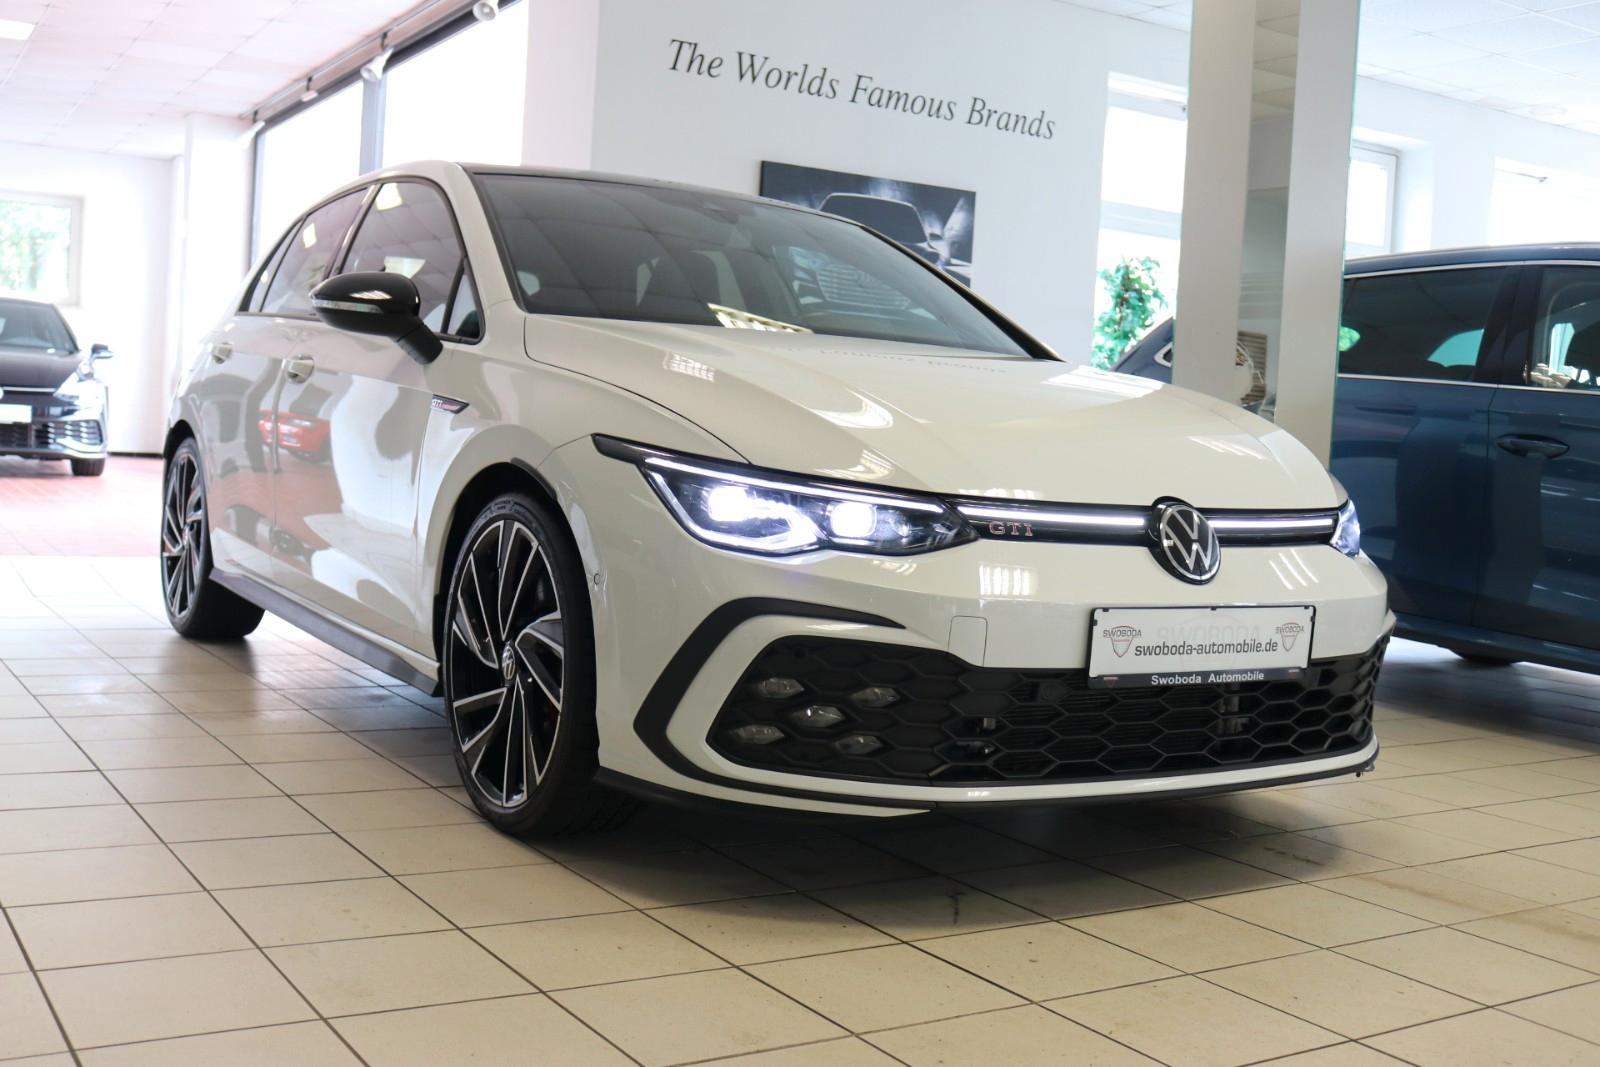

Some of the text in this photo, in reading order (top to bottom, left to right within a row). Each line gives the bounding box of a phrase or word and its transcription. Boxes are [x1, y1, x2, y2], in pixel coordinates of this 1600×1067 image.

[668, 38, 1056, 140] The Worlds Famous Brands
[988, 521, 1034, 536] GTI
[1103, 629, 1141, 638] SWOBODA
[1134, 638, 1278, 657] swoboda-automobile.de
[1151, 671, 1265, 685] Swoboda Automobile
